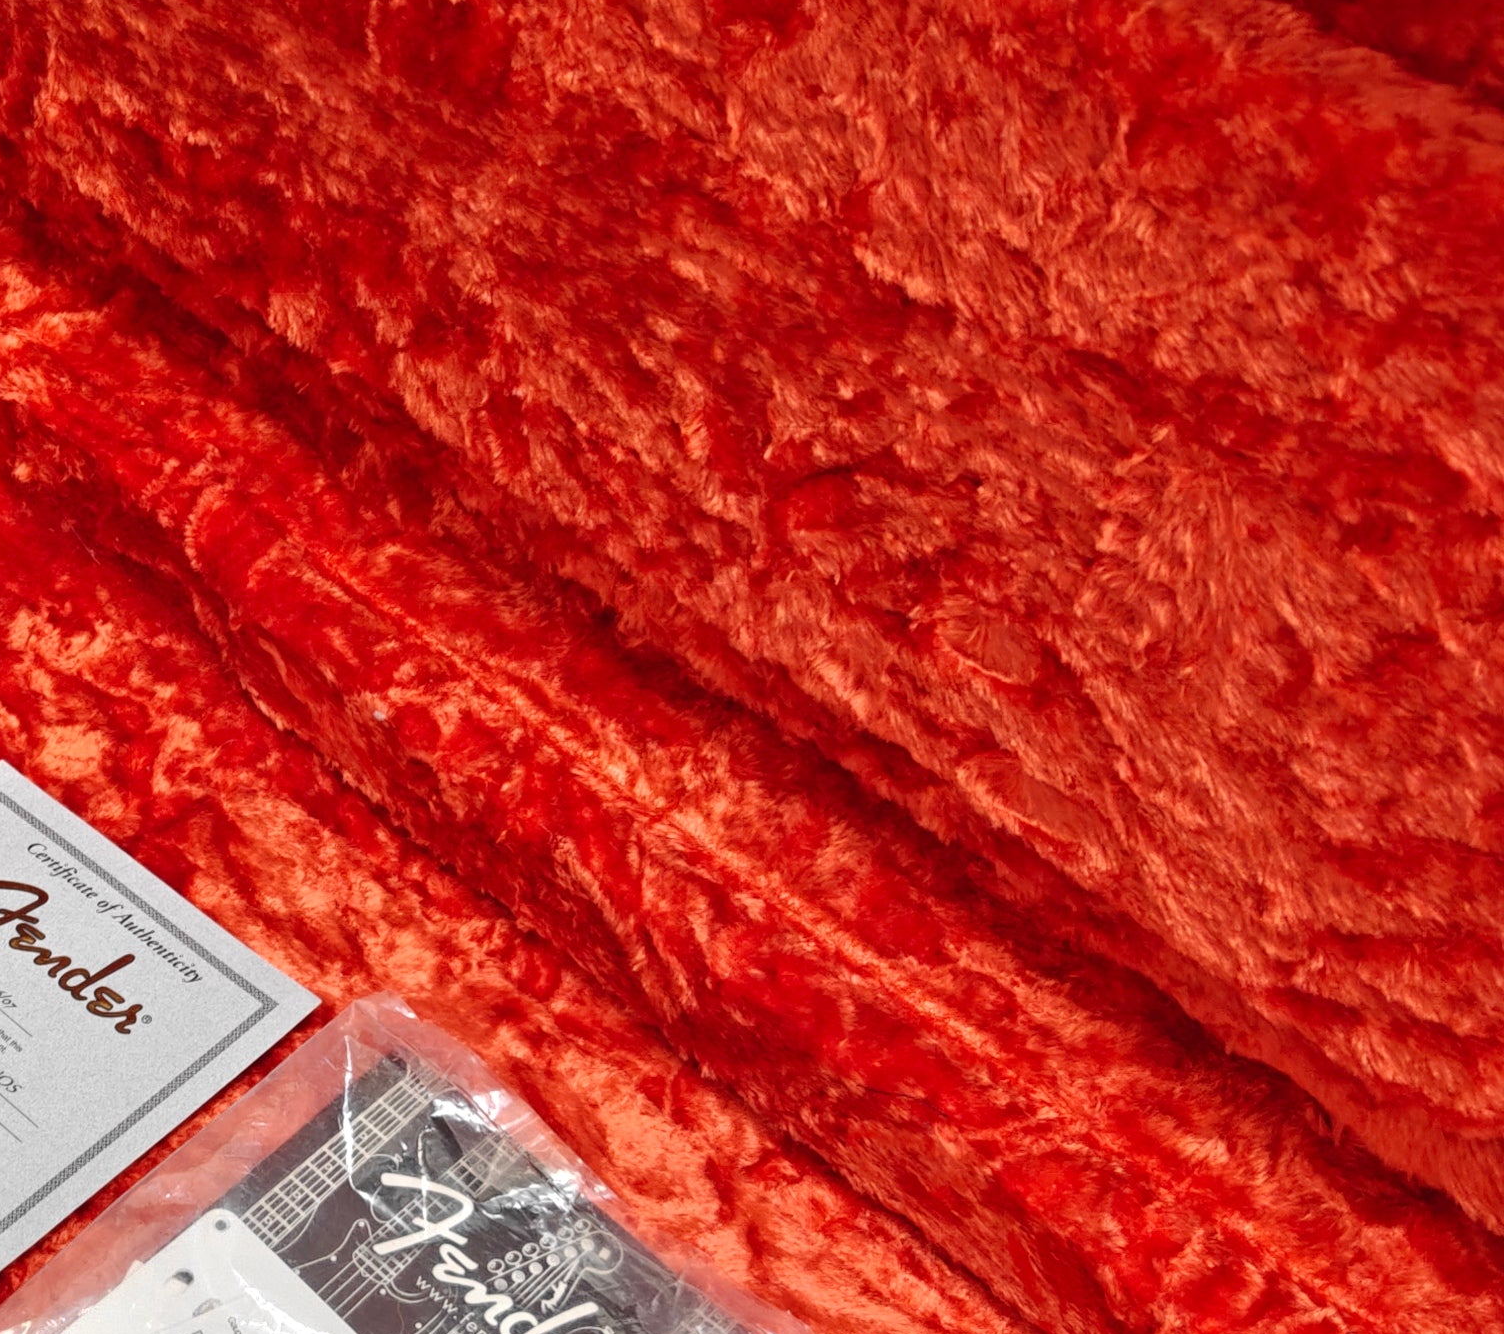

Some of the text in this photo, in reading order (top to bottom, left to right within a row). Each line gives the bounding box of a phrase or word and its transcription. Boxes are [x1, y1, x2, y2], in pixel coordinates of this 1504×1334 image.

[27, 843, 203, 983] Certificate of Authenticity
